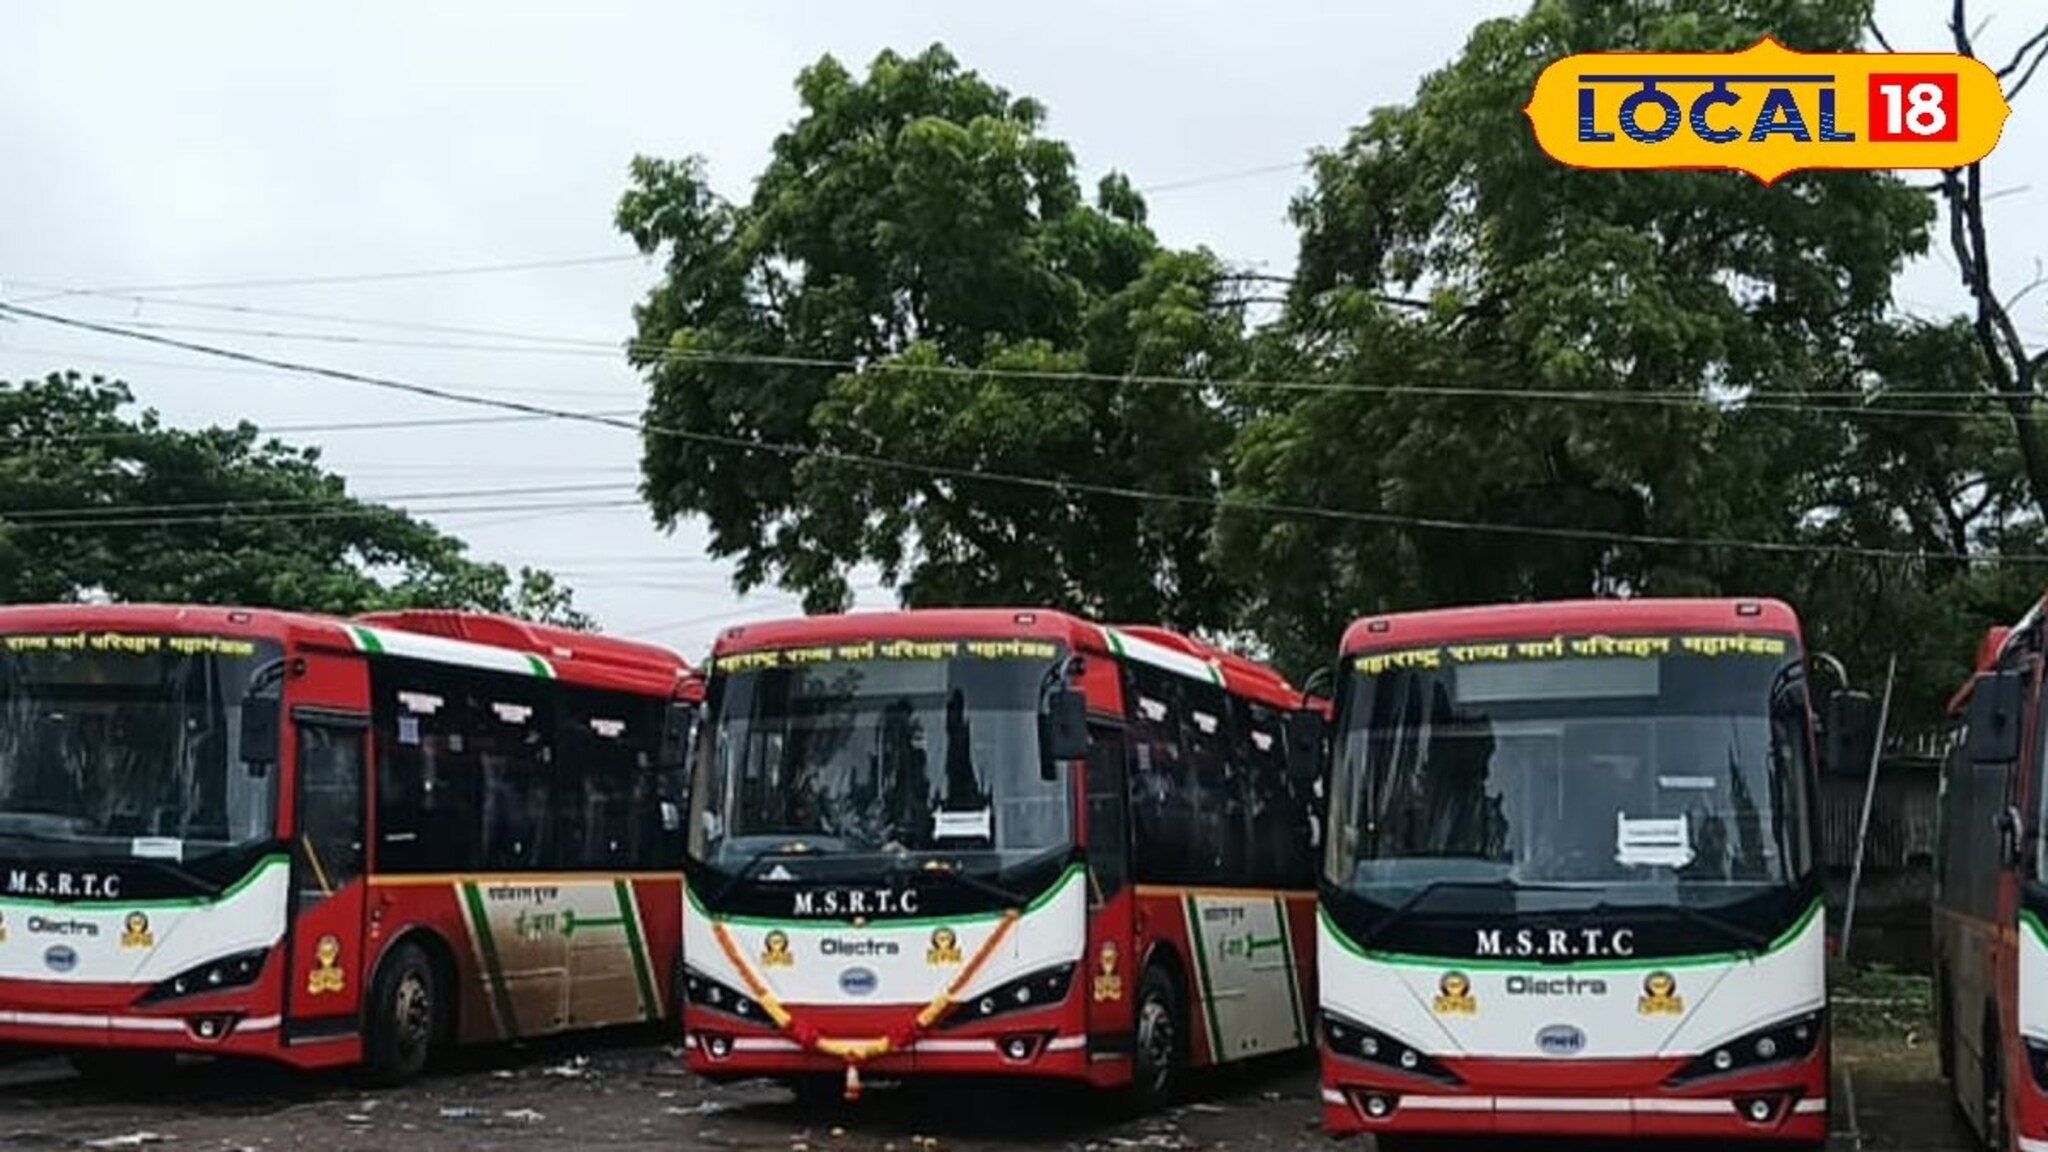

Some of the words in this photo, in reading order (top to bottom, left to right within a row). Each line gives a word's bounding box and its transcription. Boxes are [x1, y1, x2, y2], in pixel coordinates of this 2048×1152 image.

[1354, 648, 1441, 675] महाराष्ट्र
[1448, 643, 1509, 663] राज्य
[1517, 635, 1562, 657] मार्ग
[1571, 635, 1670, 658] परिवहन
[7, 869, 121, 898] M.S.R.T.C
[793, 889, 919, 915] M.S.R.T.C
[820, 937, 901, 956] Olectra
[1475, 929, 1635, 956] M.S.R.T.C
[1506, 975, 1608, 996] Olectra
